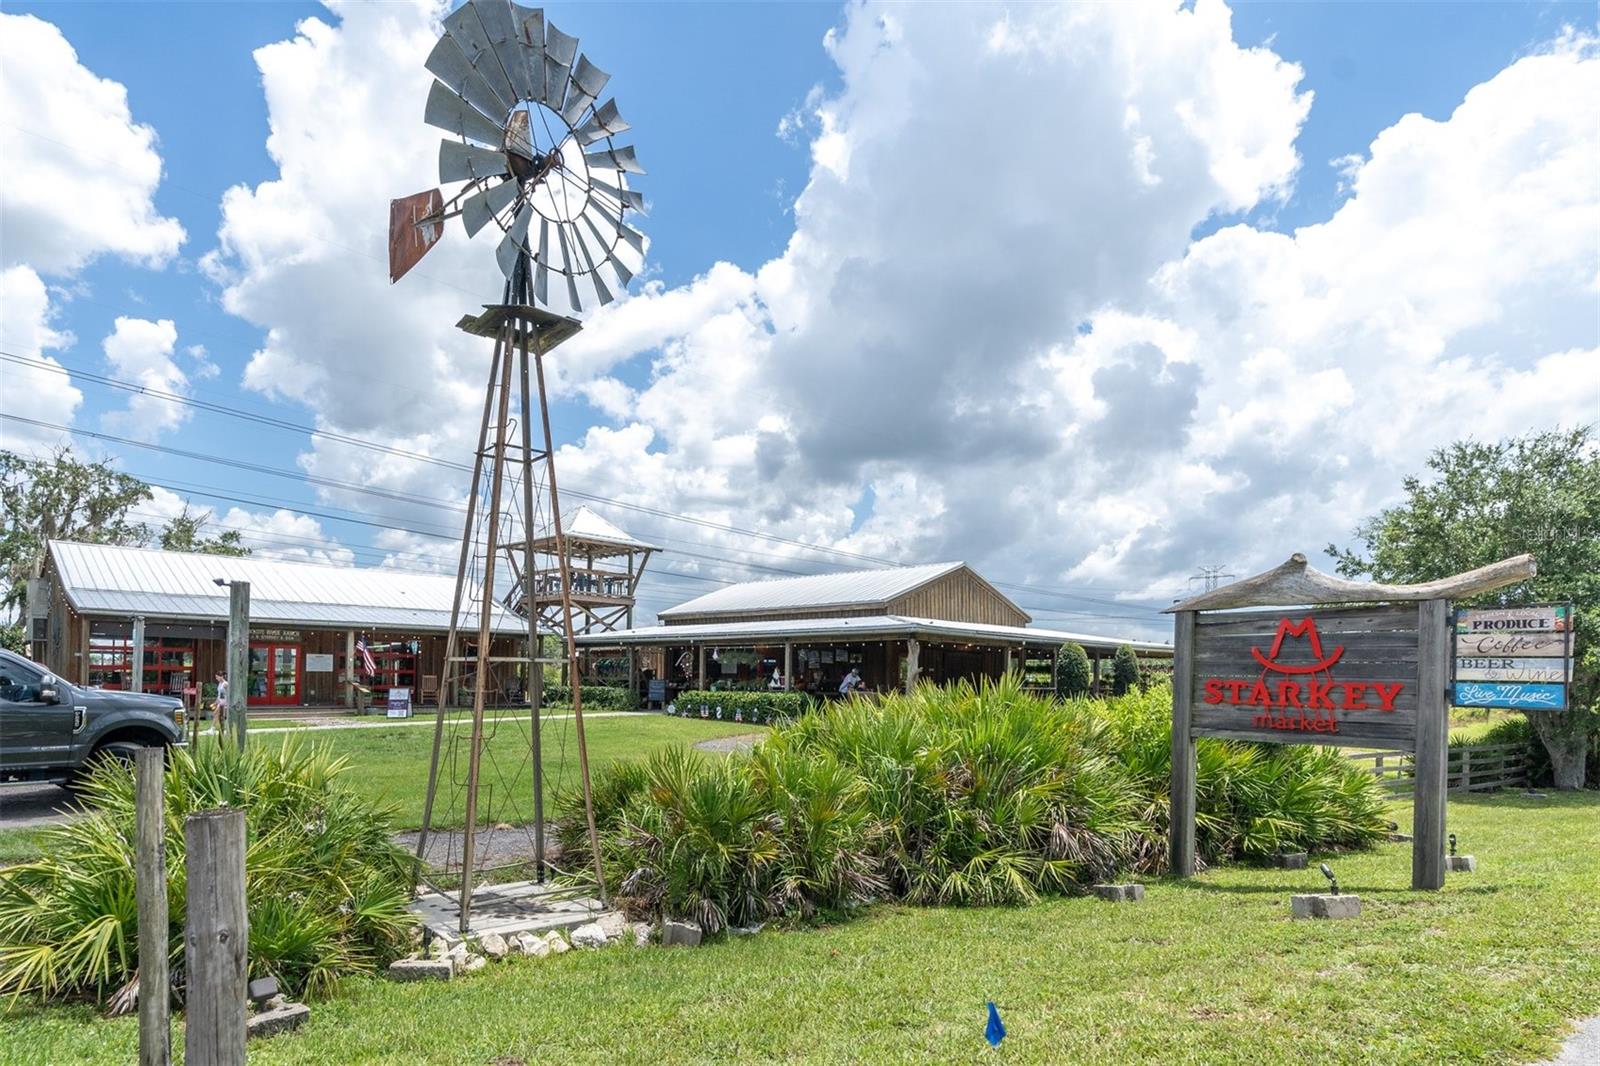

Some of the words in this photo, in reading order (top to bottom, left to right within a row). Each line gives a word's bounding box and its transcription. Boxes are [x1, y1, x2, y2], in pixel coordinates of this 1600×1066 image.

[1472, 619, 1550, 630] PRODUCE
[1463, 636, 1563, 654] Coffee
[1461, 659, 1515, 669] BEER
[1506, 661, 1564, 680] Wine
[1203, 680, 1405, 712] STARKEY
[1459, 685, 1496, 704] Live
[1497, 685, 1556, 705] Music
[1253, 714, 1339, 733] market
